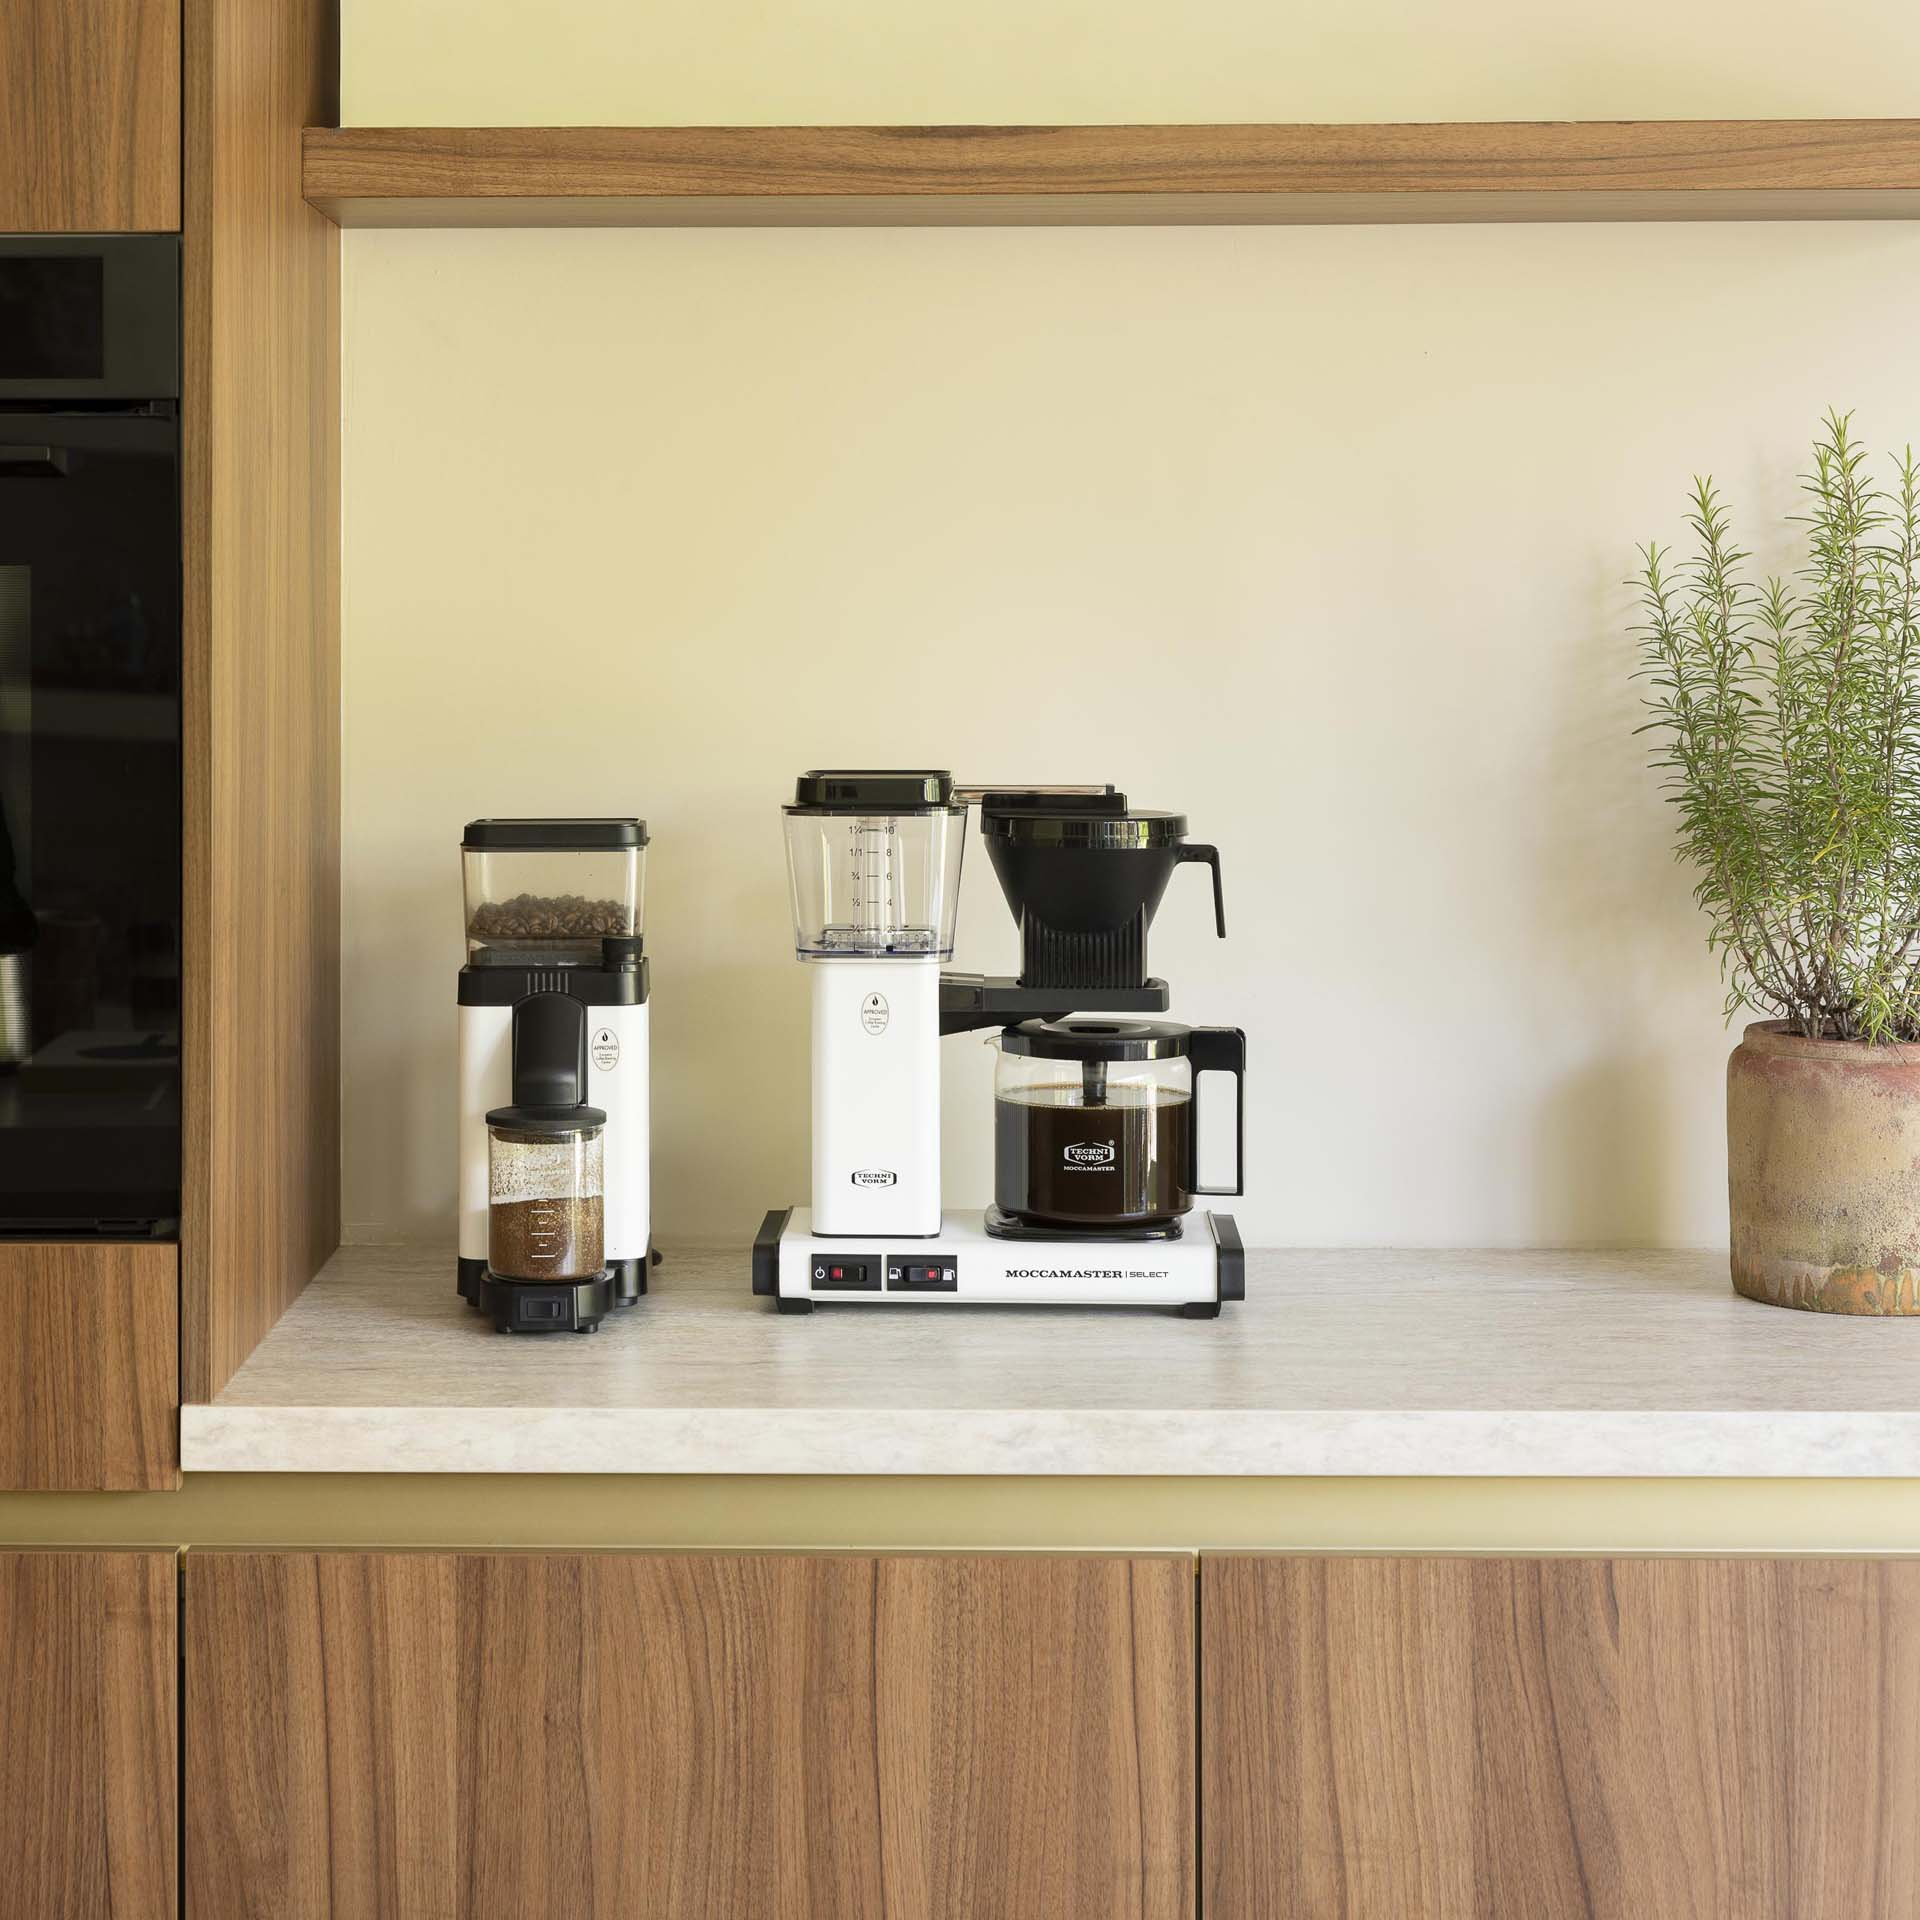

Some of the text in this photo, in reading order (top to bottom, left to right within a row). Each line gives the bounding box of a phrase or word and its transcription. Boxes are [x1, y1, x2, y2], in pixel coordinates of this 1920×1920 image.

[886, 848, 892, 857] 8
[886, 871, 892, 881] 6
[886, 898, 892, 907] 4
[1005, 1269, 1123, 1279] MOCCAMASTER
